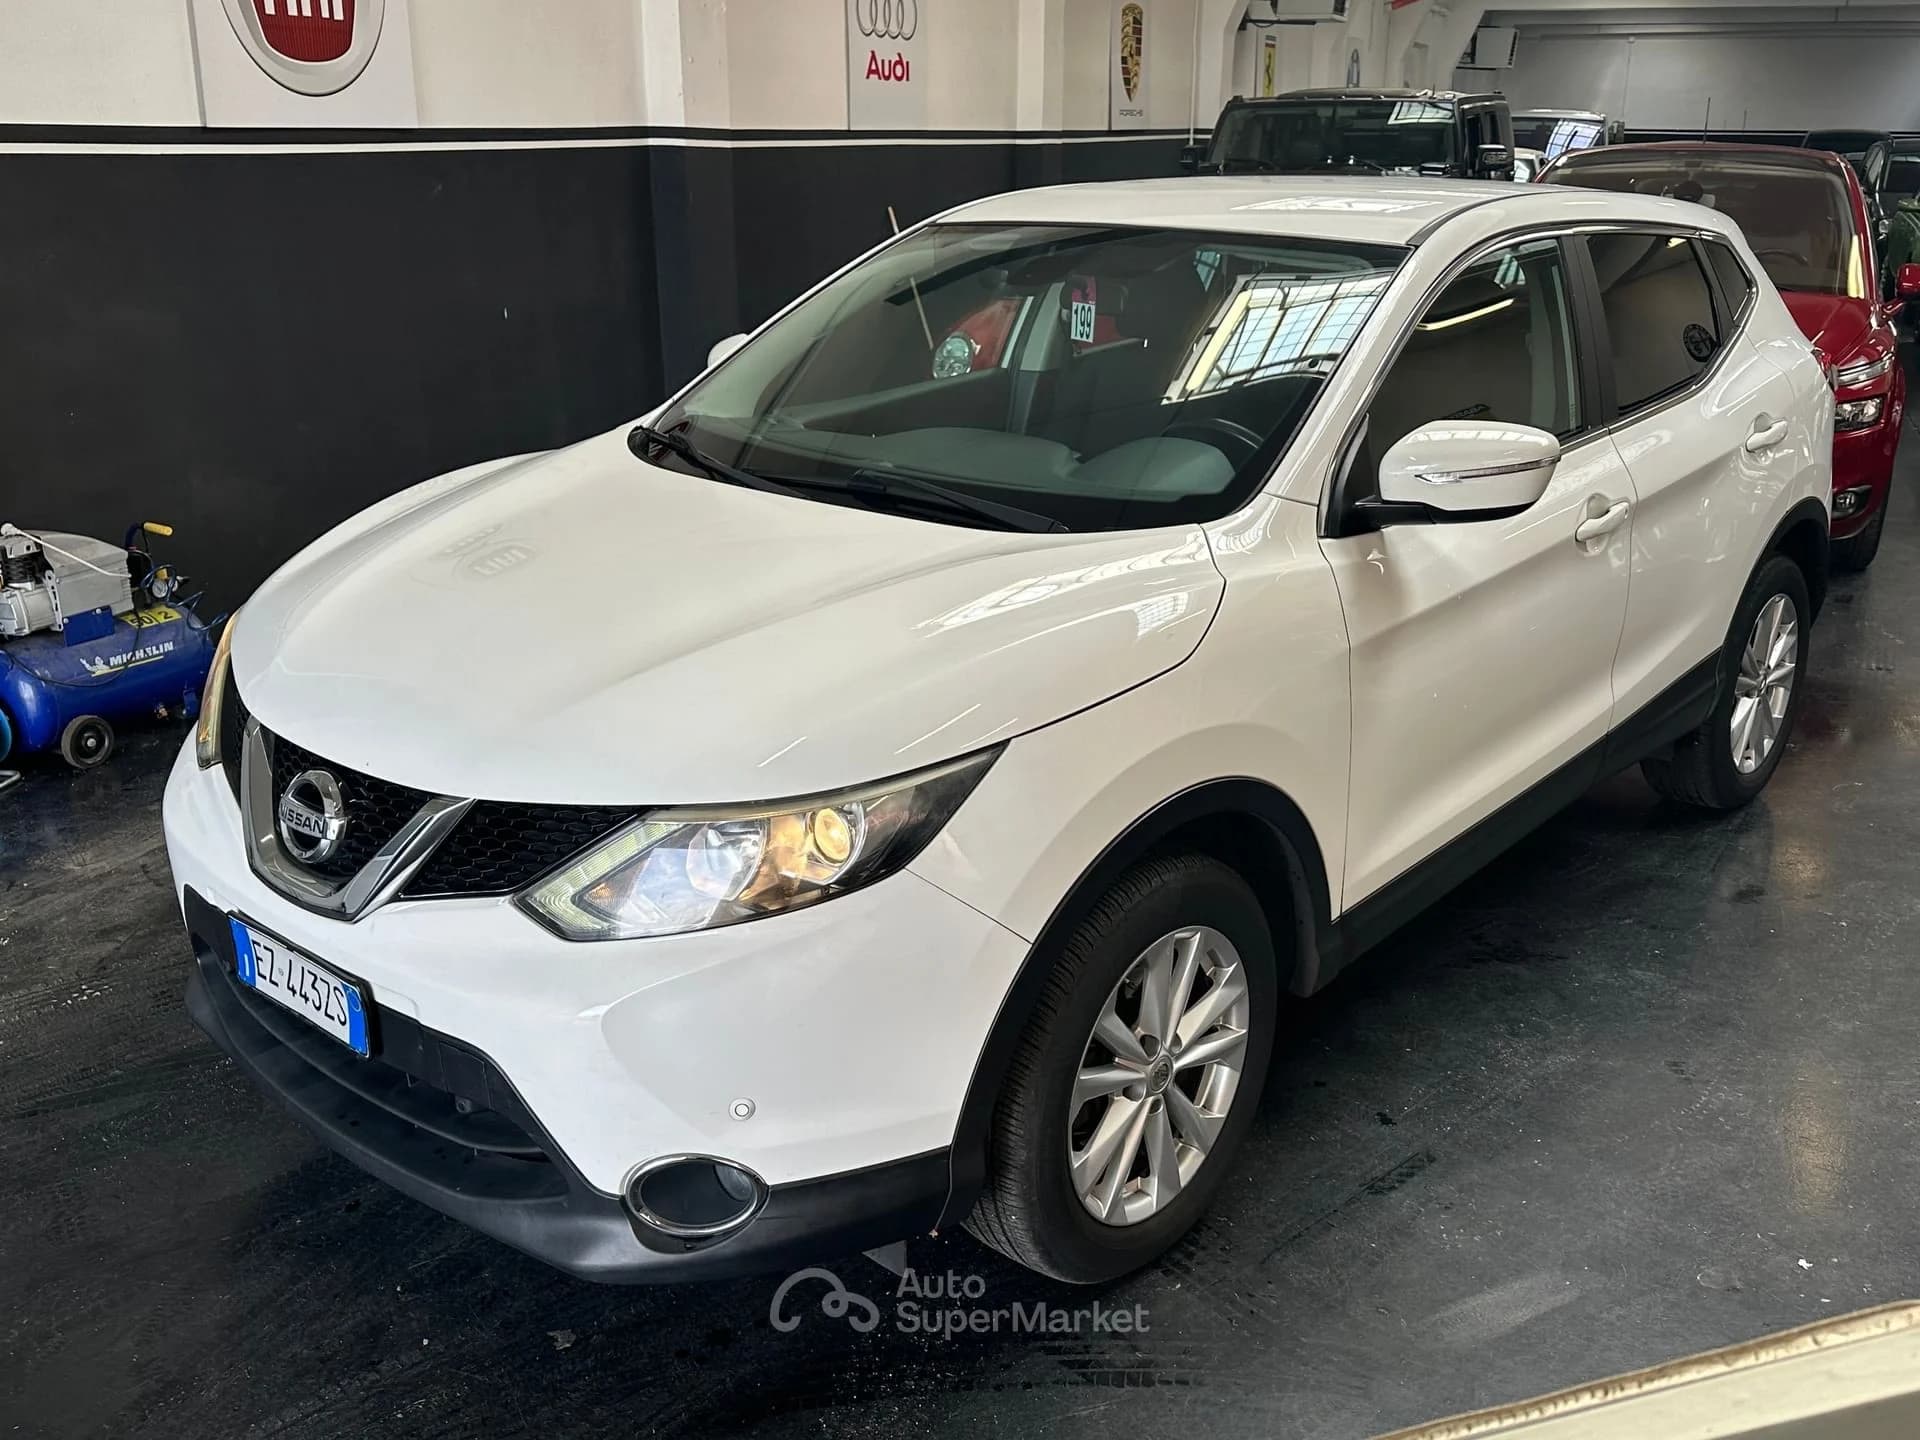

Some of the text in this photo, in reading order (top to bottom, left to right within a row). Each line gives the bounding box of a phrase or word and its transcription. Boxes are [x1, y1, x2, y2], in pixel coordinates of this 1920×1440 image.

[865, 50, 910, 82] Audi
[1074, 304, 1092, 340] 199
[108, 641, 175, 667] MICHELIN
[280, 801, 326, 835] NISSAN
